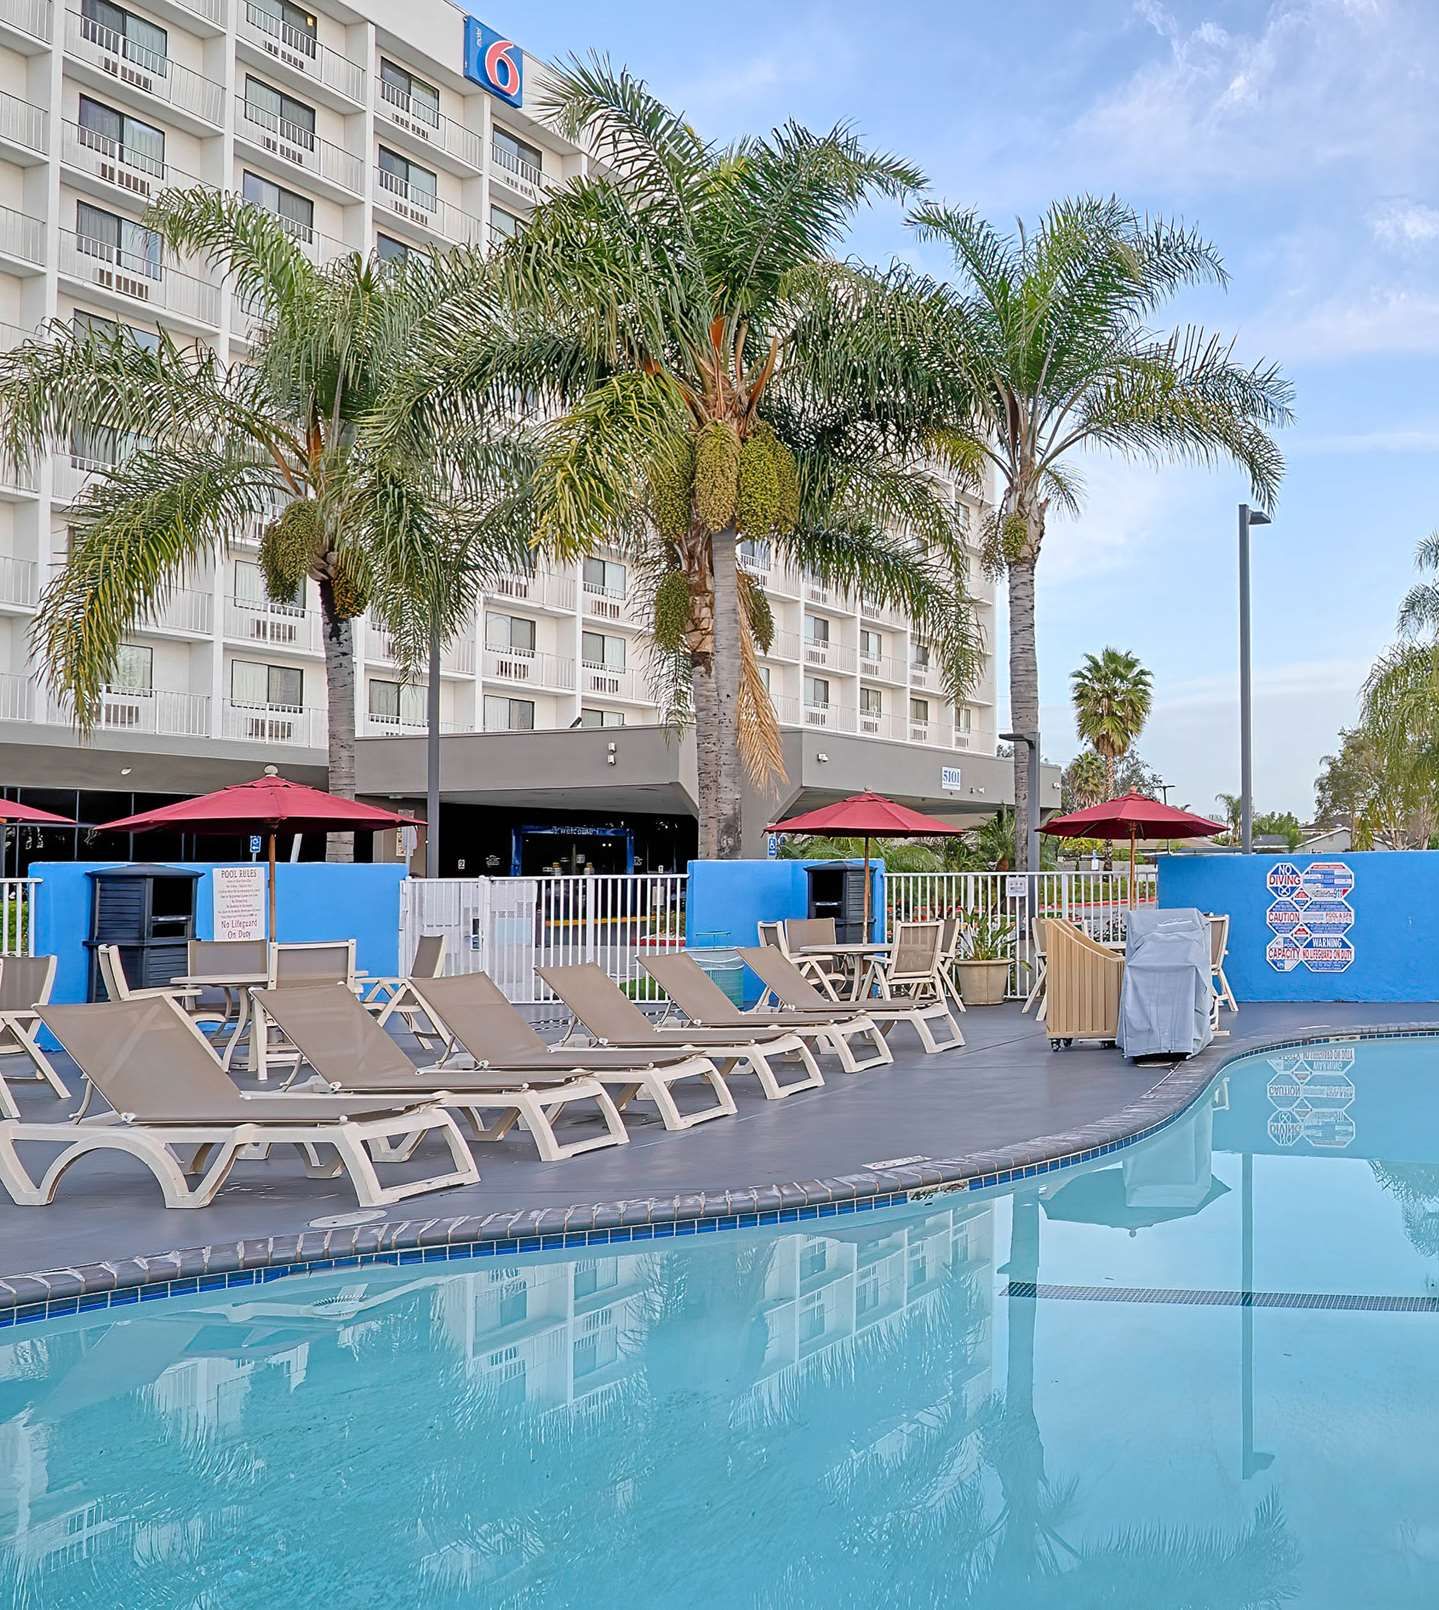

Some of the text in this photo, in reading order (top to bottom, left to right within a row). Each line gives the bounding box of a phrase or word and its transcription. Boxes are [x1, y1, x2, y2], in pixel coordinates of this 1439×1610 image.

[485, 40, 520, 96] 6
[943, 770, 960, 783] 5101
[1278, 865, 1292, 875] NO
[1269, 875, 1300, 885] DIVING
[1268, 912, 1300, 922] CAUTION
[1312, 938, 1342, 948] WARNING
[1268, 948, 1300, 959] CAPACITY
